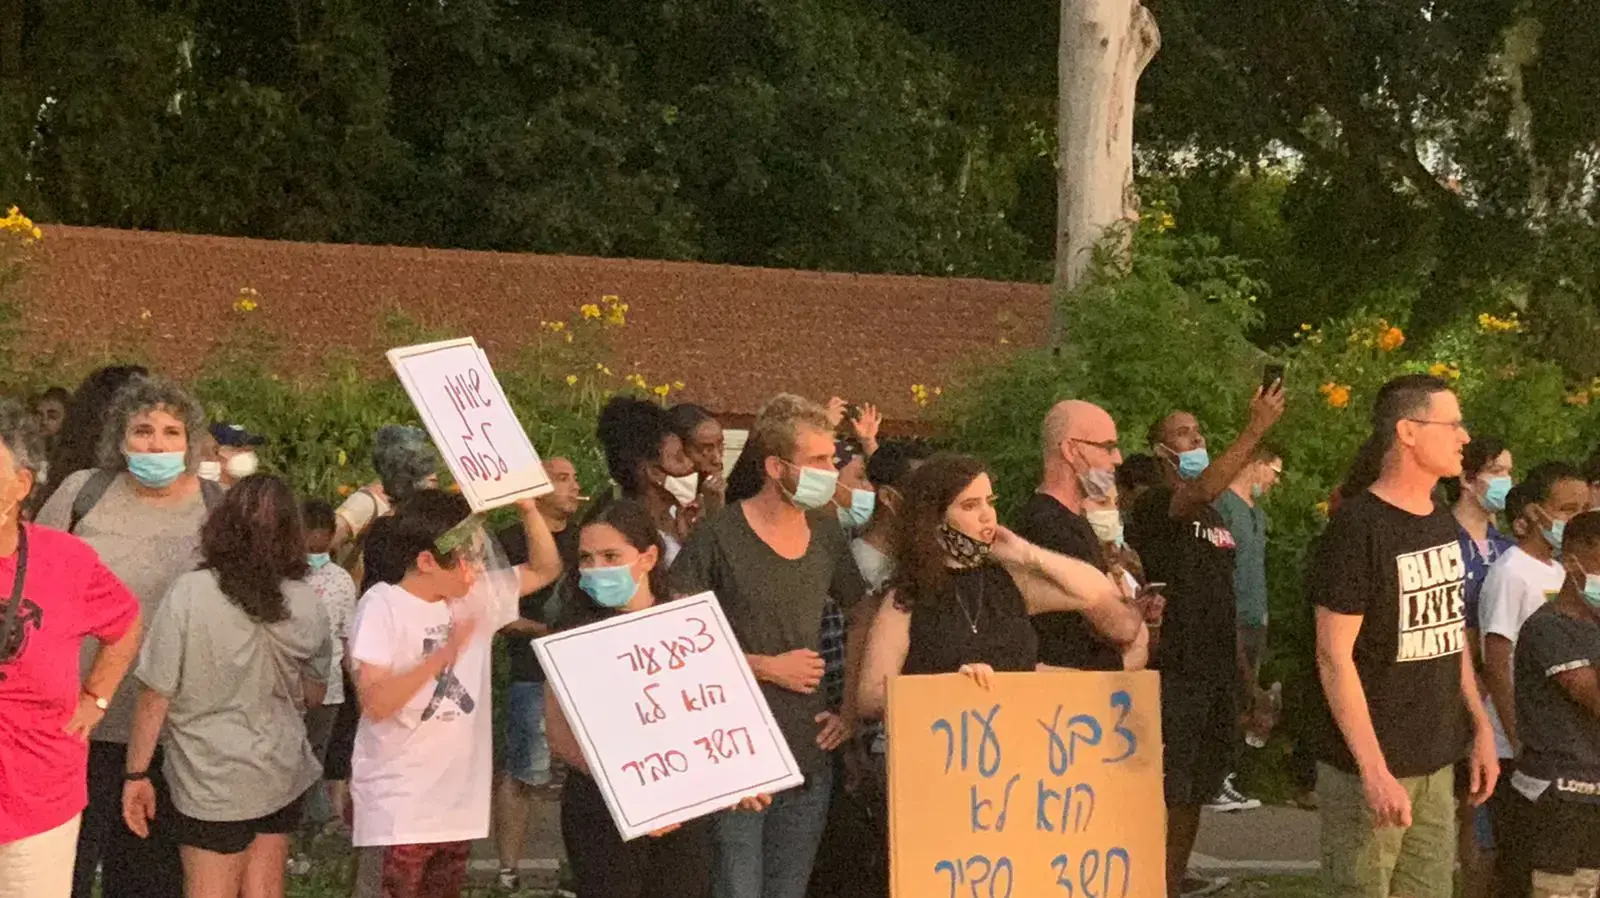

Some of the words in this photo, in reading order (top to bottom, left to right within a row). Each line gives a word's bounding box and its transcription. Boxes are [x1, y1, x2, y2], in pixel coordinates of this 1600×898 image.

[460, 422, 508, 482] לכולם
[617, 644, 662, 676] עור
[659, 617, 715, 670] צבע
[1402, 624, 1465, 659] MATT
[635, 683, 667, 726] לא
[681, 683, 726, 712] הוא
[693, 727, 756, 765] חשד
[930, 703, 1002, 778] עור
[1036, 690, 1138, 777] צבע
[621, 749, 689, 786] סביר
[970, 773, 1021, 833] לא
[1036, 778, 1096, 834] הוא
[934, 855, 1014, 898] סביר
[1050, 846, 1130, 898] חשד
